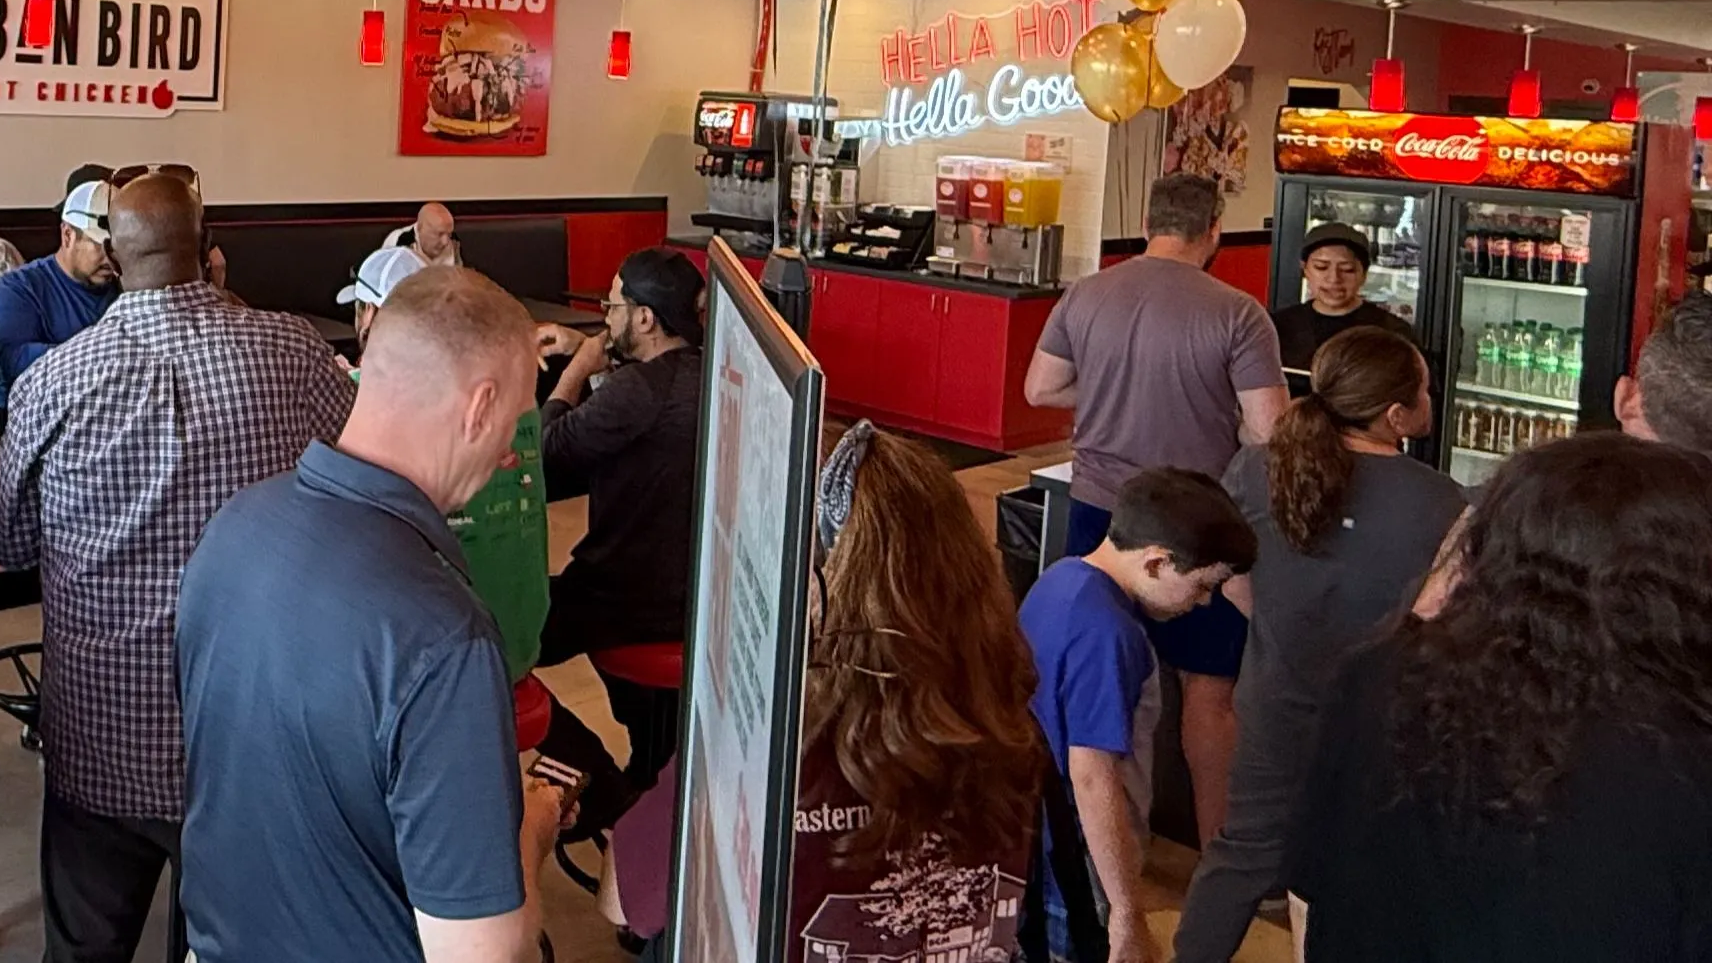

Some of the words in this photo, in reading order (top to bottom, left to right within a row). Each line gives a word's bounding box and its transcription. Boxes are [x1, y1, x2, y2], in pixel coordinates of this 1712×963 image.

[97, 0, 202, 71] BIRD
[880, 11, 997, 87] HELLA
[37, 81, 148, 104] CHICKEN
[883, 68, 980, 146] Hella
[1394, 132, 1486, 163] Coca-Cola
[1498, 145, 1620, 166] DELICIOUS
